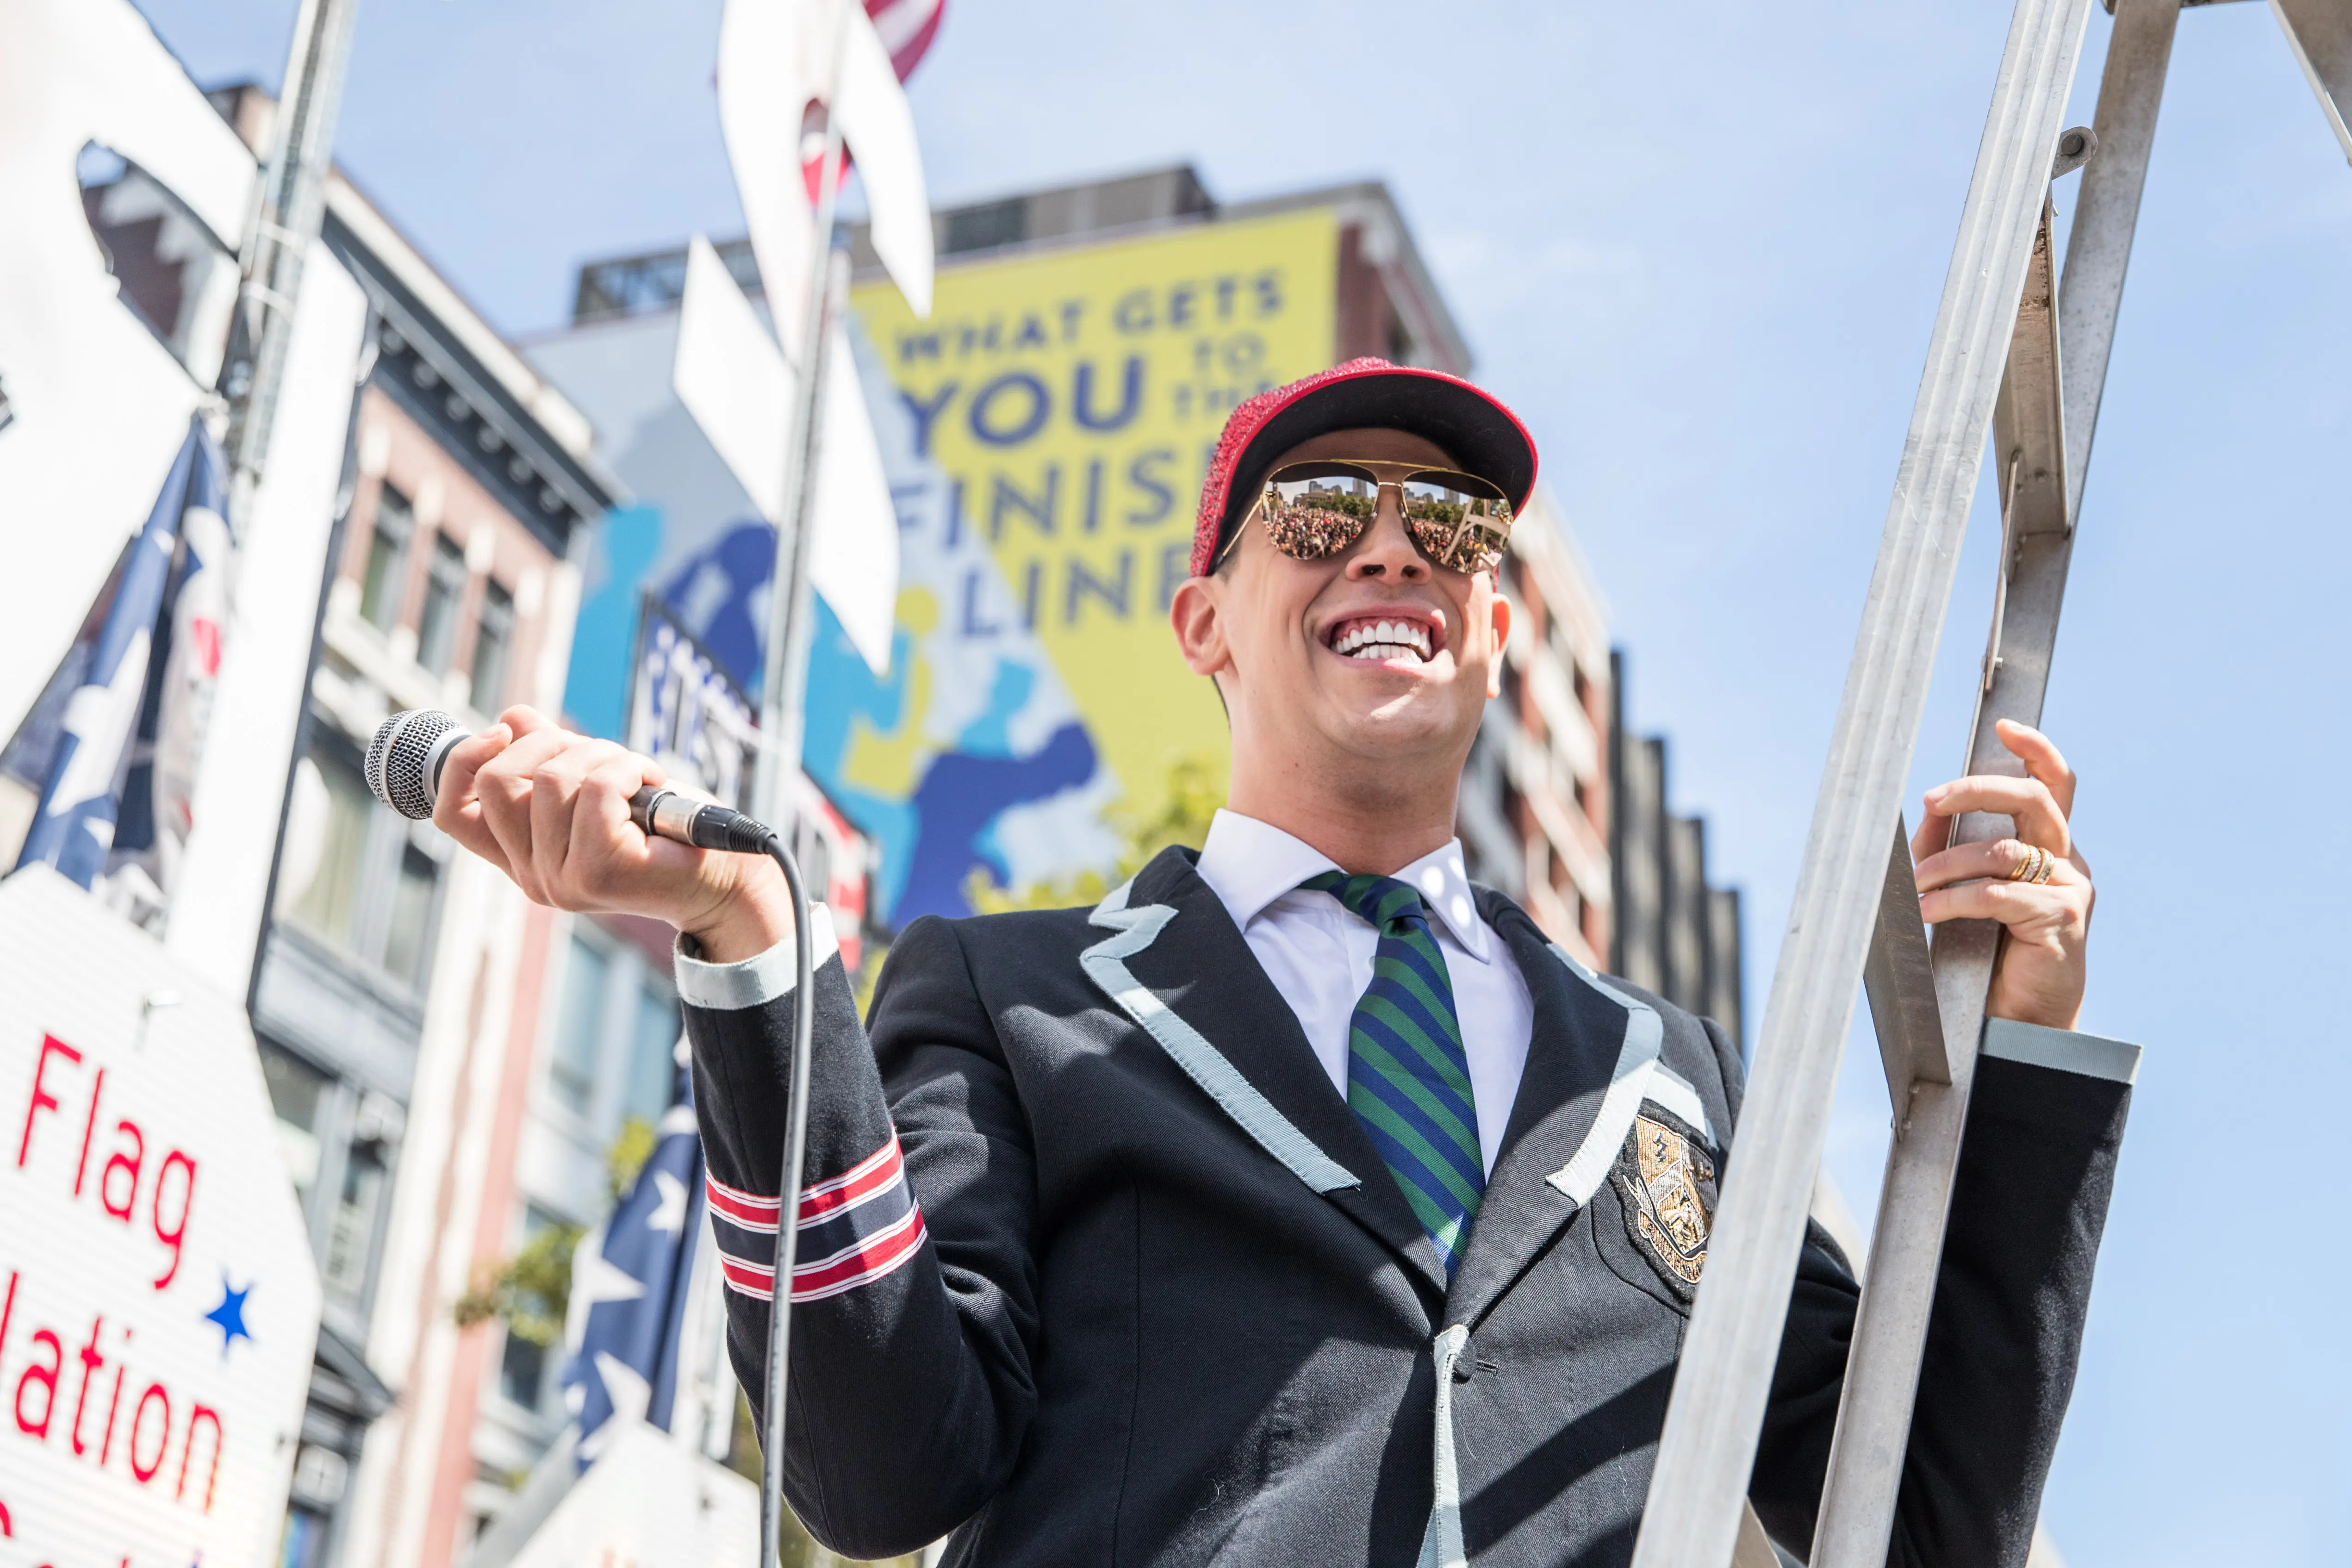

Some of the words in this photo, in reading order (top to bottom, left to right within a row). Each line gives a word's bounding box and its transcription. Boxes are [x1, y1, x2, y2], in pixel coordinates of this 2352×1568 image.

[896, 298, 1086, 365] WHAT
[1113, 271, 1285, 334] GETS
[899, 355, 1146, 458] YOU
[1175, 378, 1274, 422] TH
[888, 442, 1216, 551] FINIS
[18, 1032, 197, 1290] Flag
